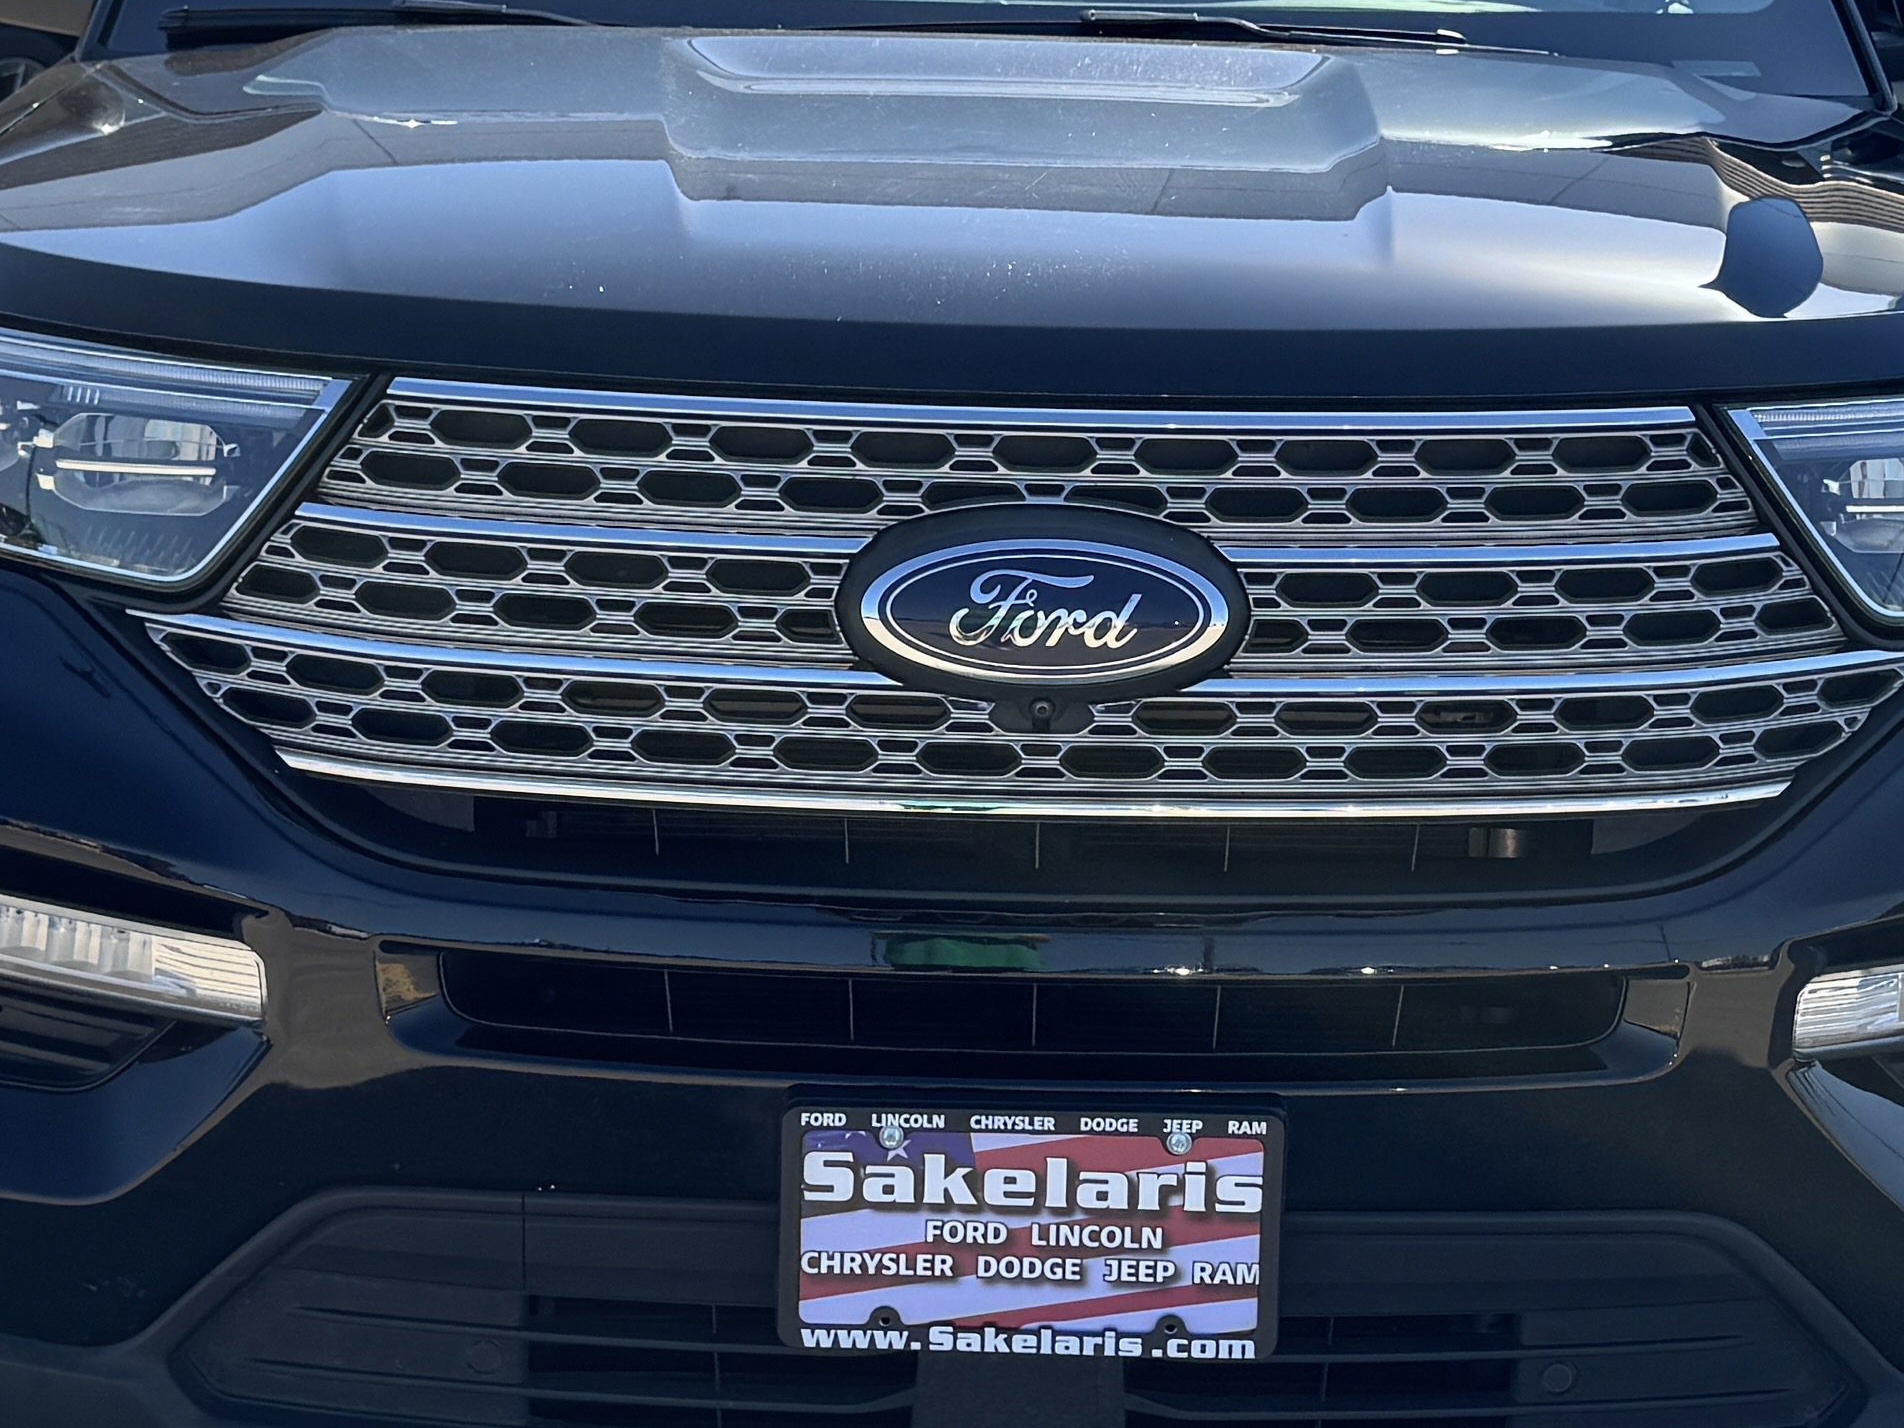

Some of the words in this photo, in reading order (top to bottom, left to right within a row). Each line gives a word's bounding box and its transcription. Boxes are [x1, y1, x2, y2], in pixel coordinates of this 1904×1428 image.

[947, 568, 1144, 649] Ford
[800, 1112, 847, 1128] FORD
[871, 1113, 945, 1129] LINCOLN
[969, 1115, 1056, 1131] CHRYSLER
[1079, 1117, 1139, 1133] DODGE
[1162, 1118, 1204, 1134] JEEP
[1227, 1120, 1268, 1136] RAM
[802, 1151, 1264, 1213] Sakelaris
[925, 1220, 1009, 1245] FORD
[1030, 1223, 1164, 1250] LINCOLN
[800, 1250, 955, 1278] CHRYSLER
[976, 1255, 1082, 1281] DODGE
[1103, 1259, 1176, 1284] JEEP
[1192, 1261, 1260, 1286] RAM
